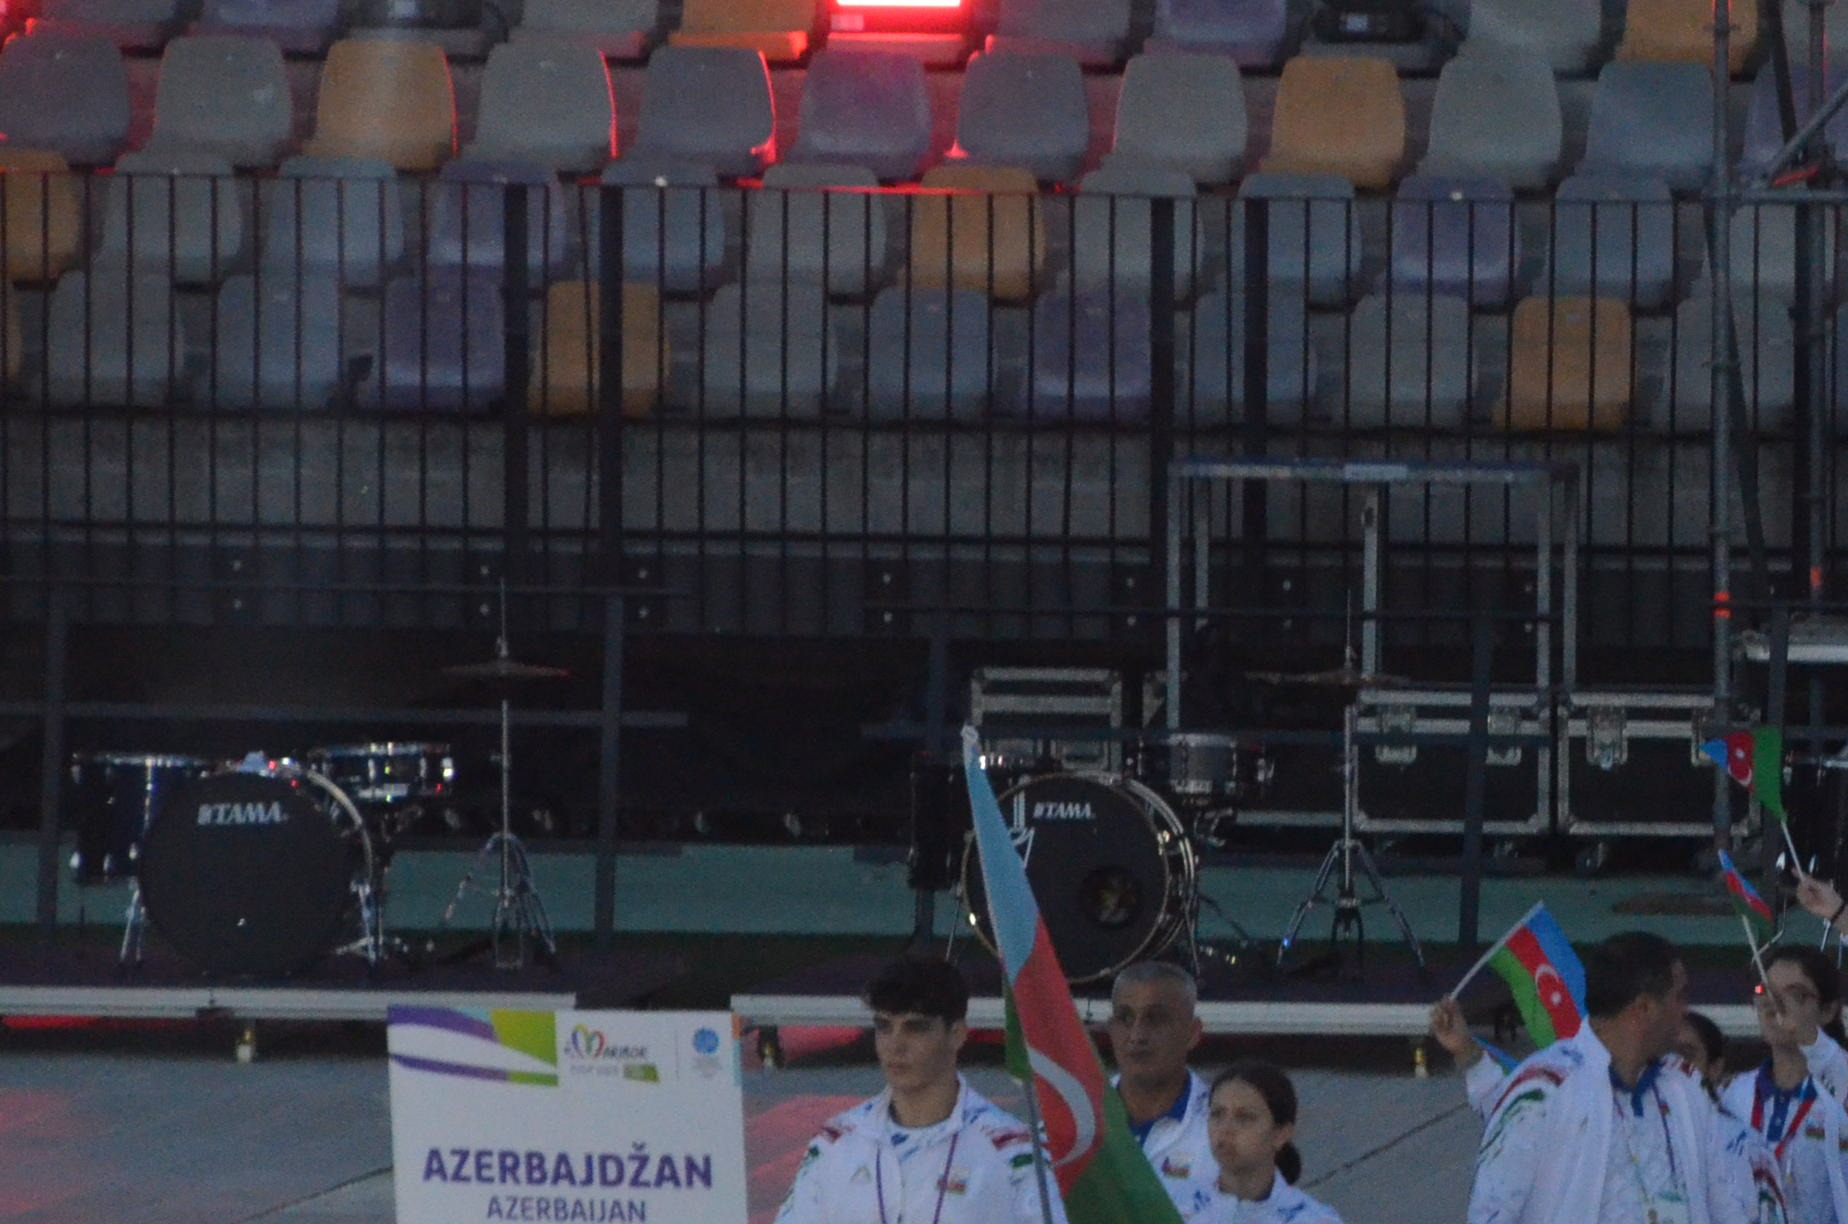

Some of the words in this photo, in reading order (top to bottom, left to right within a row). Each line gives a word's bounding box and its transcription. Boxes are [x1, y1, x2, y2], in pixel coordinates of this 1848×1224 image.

[211, 801, 280, 823] TAMA
[1044, 801, 1091, 819] TAMA
[424, 1142, 713, 1189] AZERBAJDŽAN
[486, 1195, 647, 1223] AZERBAIJAN
